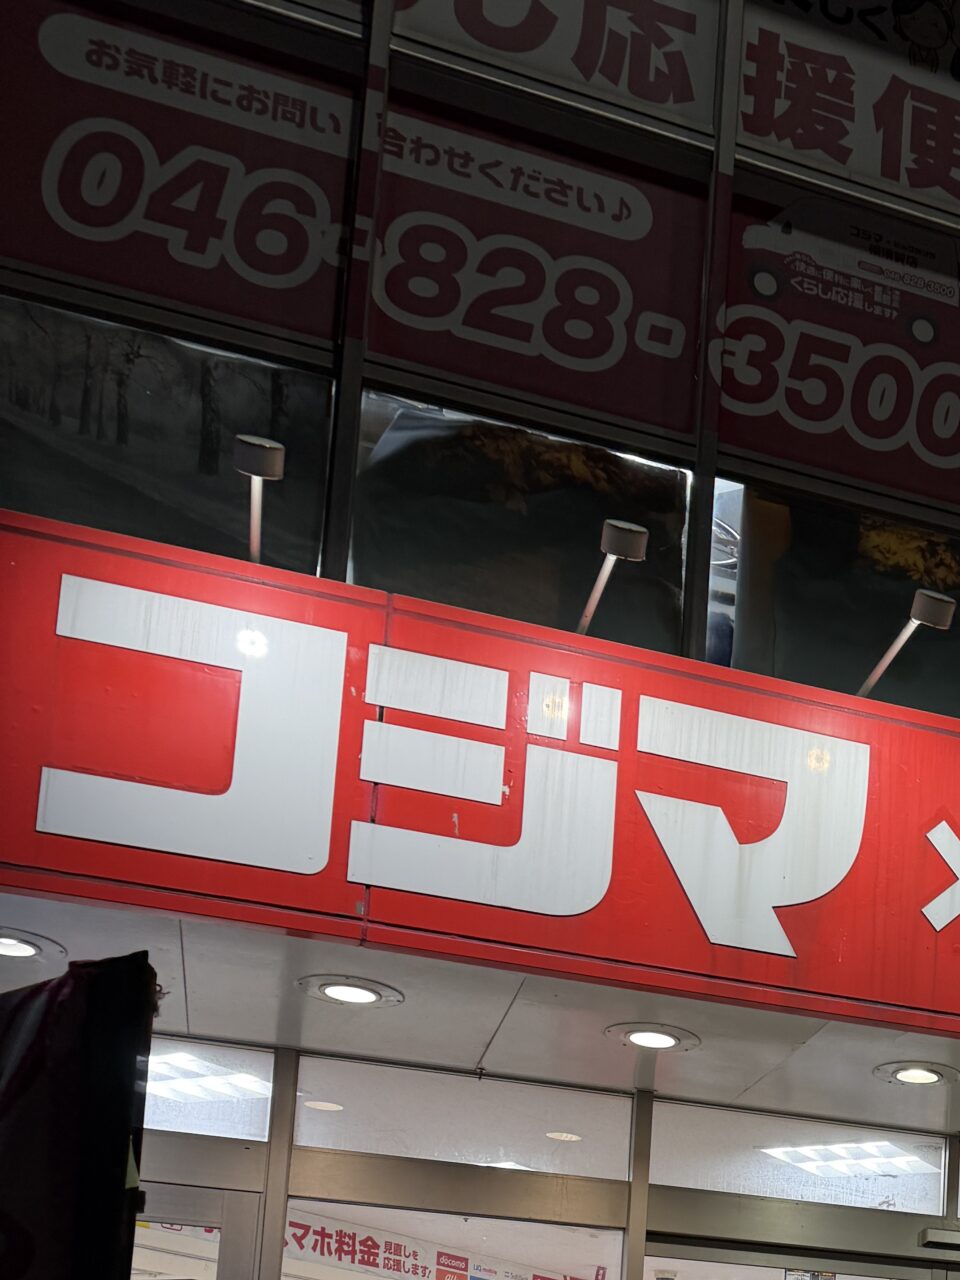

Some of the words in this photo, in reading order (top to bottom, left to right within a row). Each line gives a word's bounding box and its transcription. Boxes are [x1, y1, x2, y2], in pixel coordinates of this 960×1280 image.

[36, 573, 871, 958] コジマ
[283, 1220, 381, 1268] マホ料金
[384, 1240, 419, 1261] 見直しを
